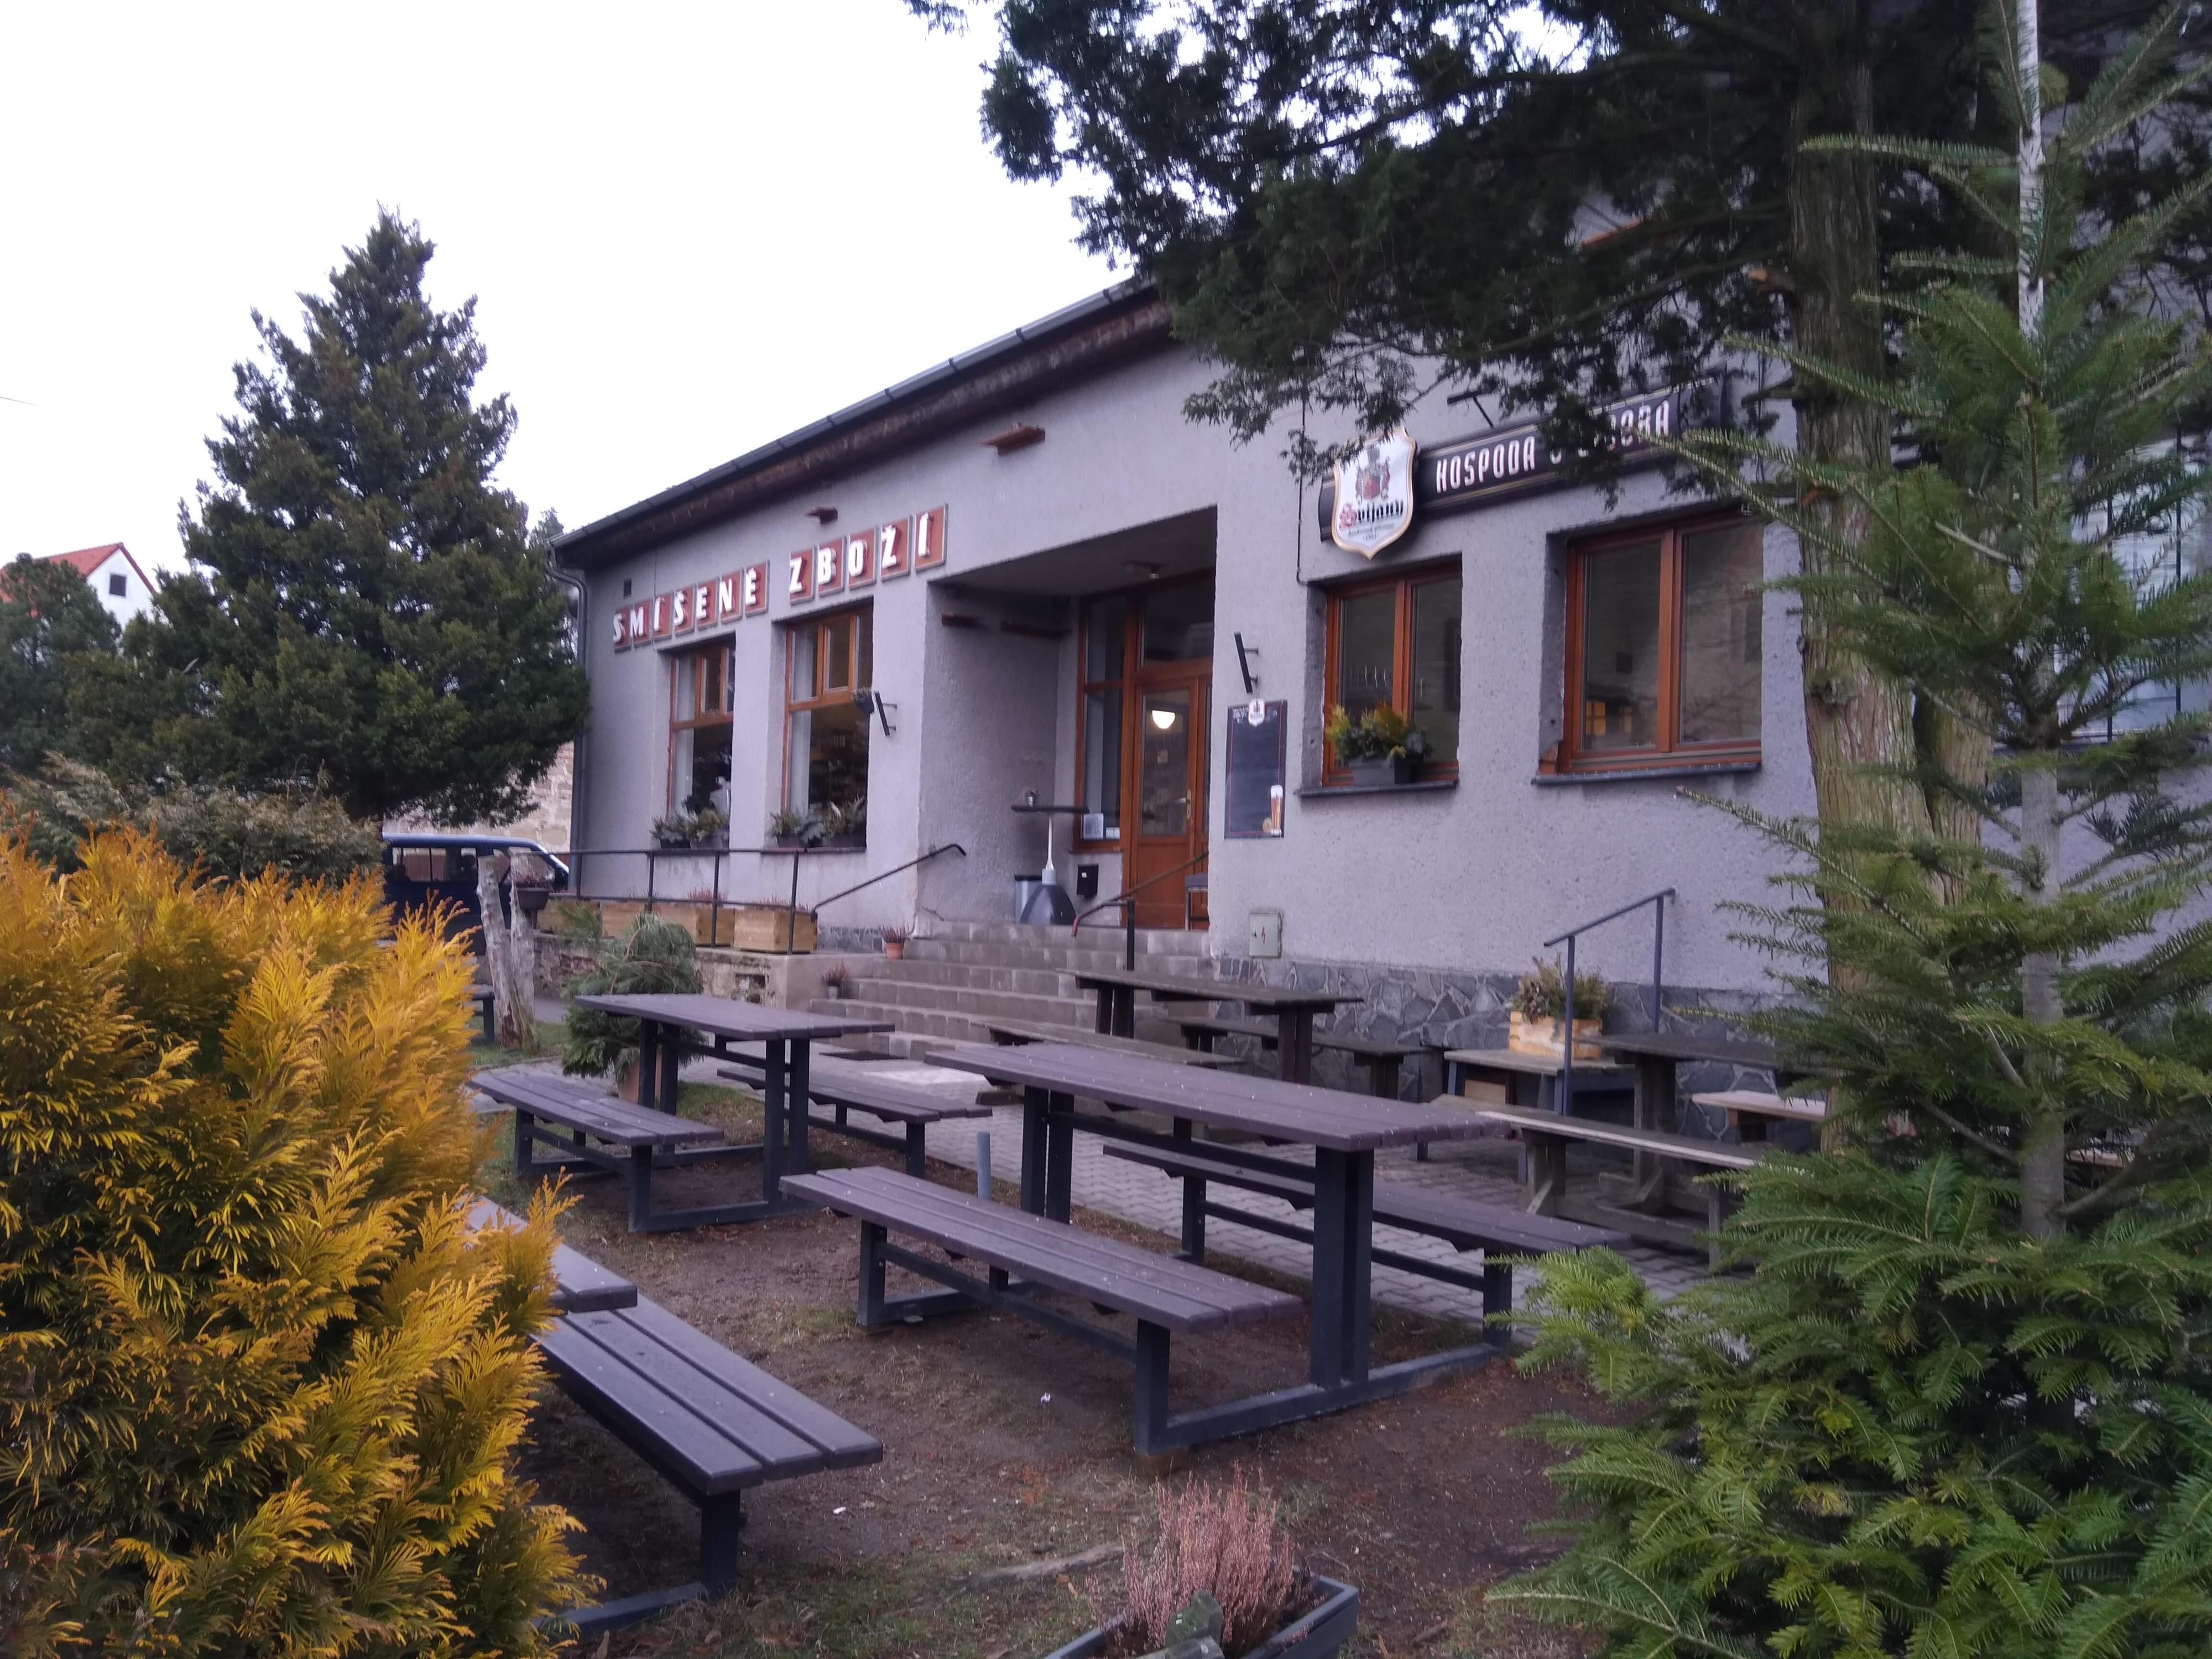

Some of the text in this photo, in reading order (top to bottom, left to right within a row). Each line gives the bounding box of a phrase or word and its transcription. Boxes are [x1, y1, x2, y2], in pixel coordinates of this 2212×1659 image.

[1436, 435, 1536, 494] HOSPODA
[612, 512, 931, 643] SMÍŠENÉ ZBOŽÍ
